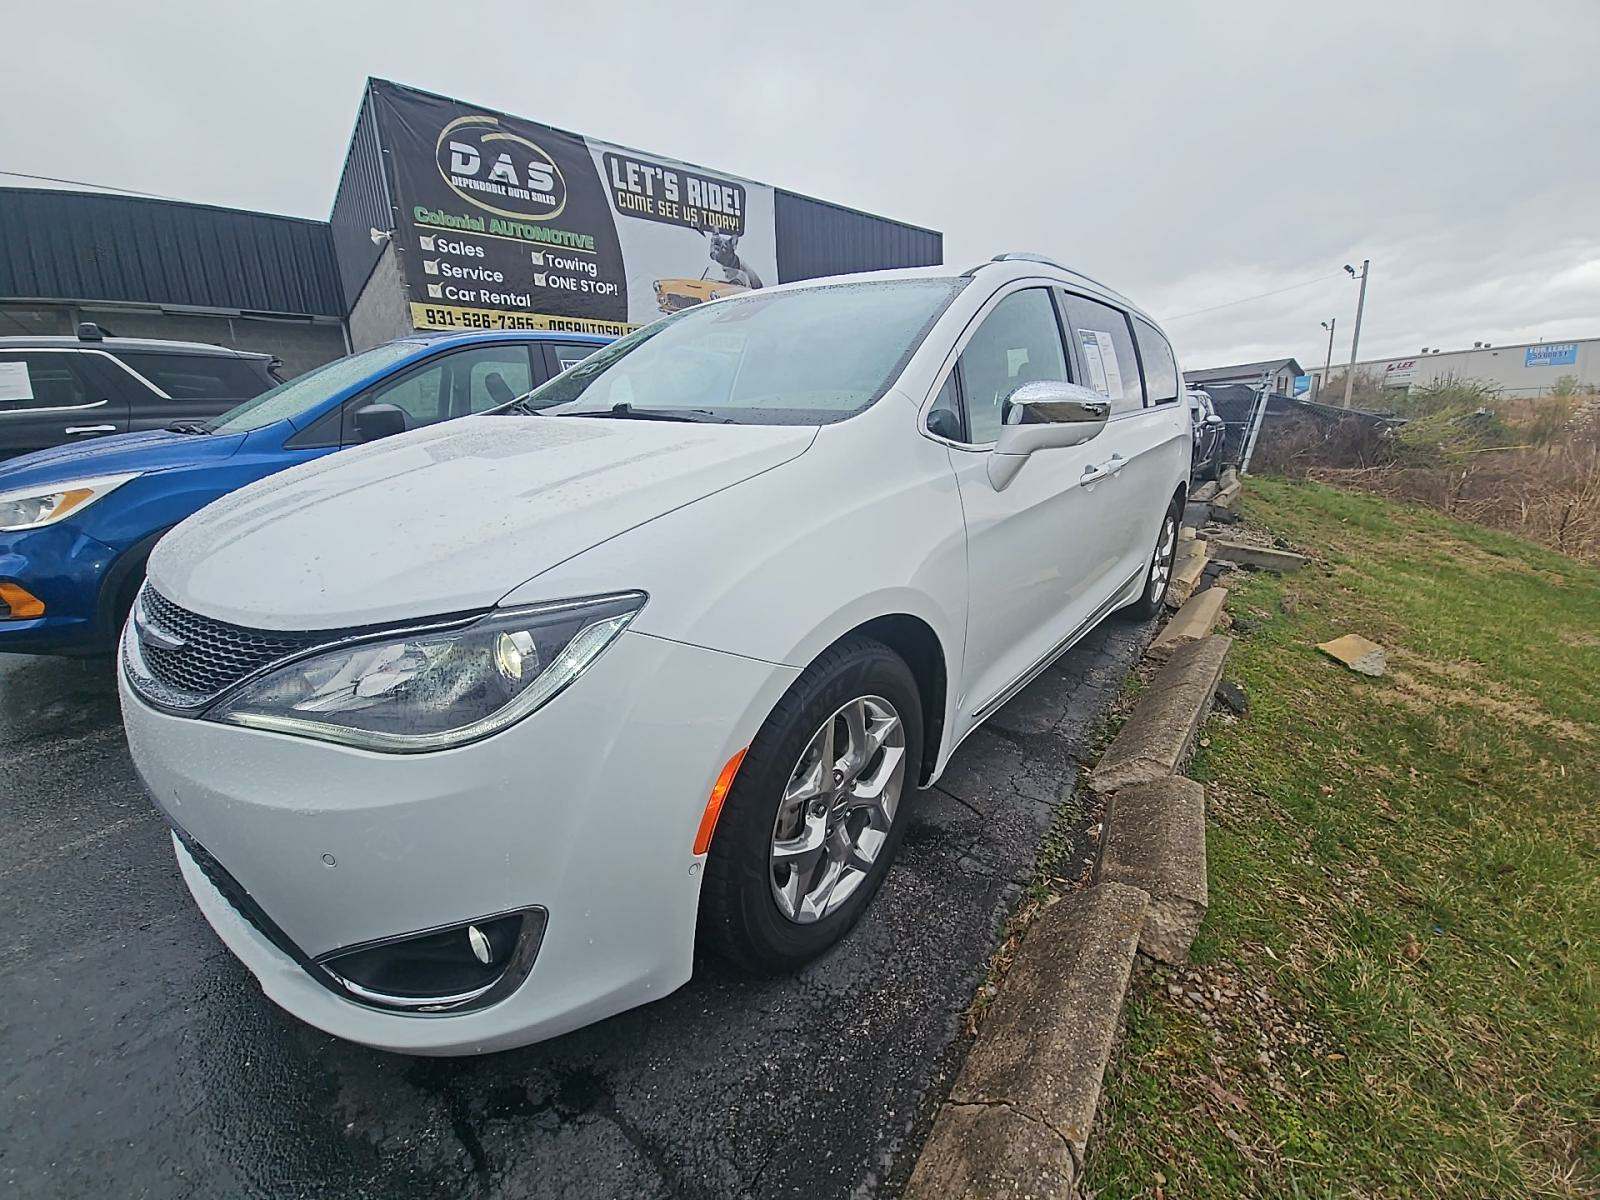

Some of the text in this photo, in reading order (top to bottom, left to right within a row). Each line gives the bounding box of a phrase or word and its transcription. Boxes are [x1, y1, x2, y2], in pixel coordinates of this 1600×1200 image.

[449, 141, 554, 192] DAS
[451, 175, 556, 206] DEPENDABLE AUTO SALES
[610, 157, 741, 216] LET'S RIDE!
[618, 191, 739, 231] COME SEE US TODAY!
[414, 206, 595, 249] Colonial AUTOMOTIVE
[437, 238, 485, 258] Sales
[441, 263, 504, 282] Service
[546, 253, 597, 277] Towing
[445, 286, 531, 307] Car Rental
[548, 275, 618, 296] ONE STOP!
[425, 309, 640, 336] 931-526-7355 DASAUTOSALE
